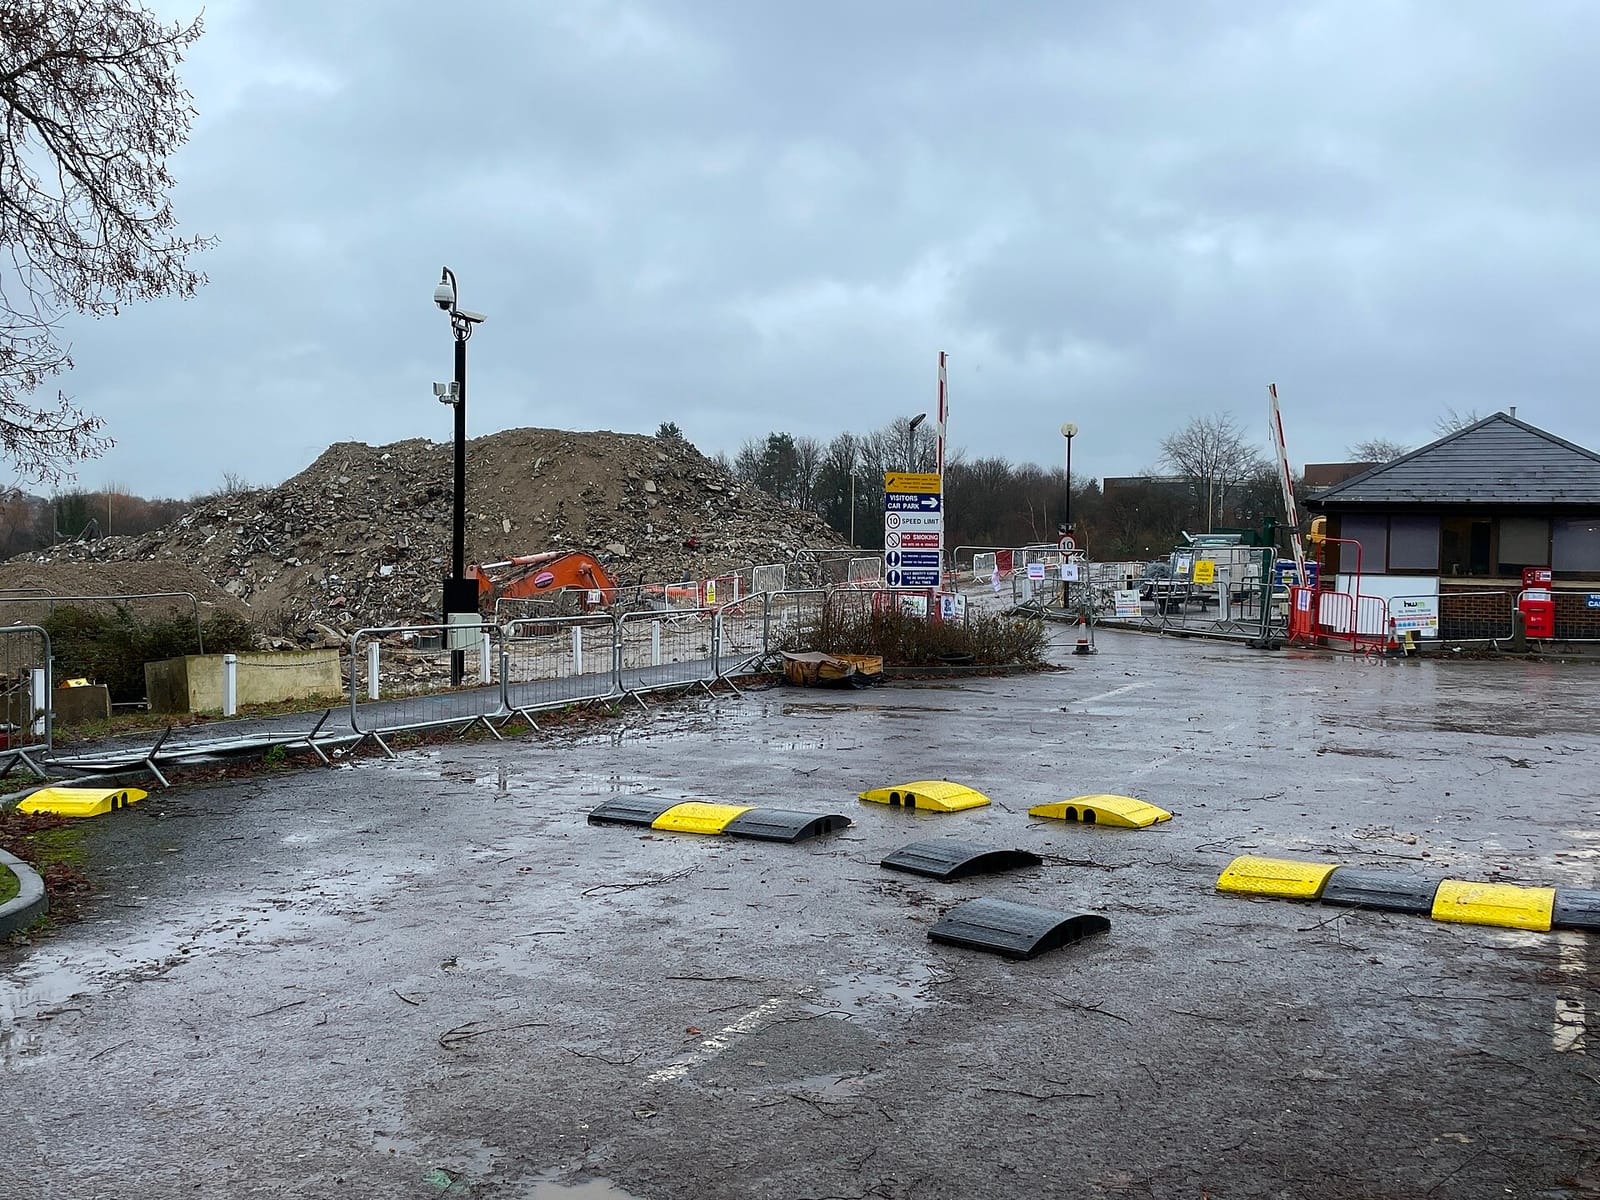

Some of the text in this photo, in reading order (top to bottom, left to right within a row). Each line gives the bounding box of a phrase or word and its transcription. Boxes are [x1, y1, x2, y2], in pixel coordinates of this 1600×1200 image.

[902, 502, 920, 510] PARK
[889, 517, 898, 525] 10
[1062, 541, 1073, 550] 10
